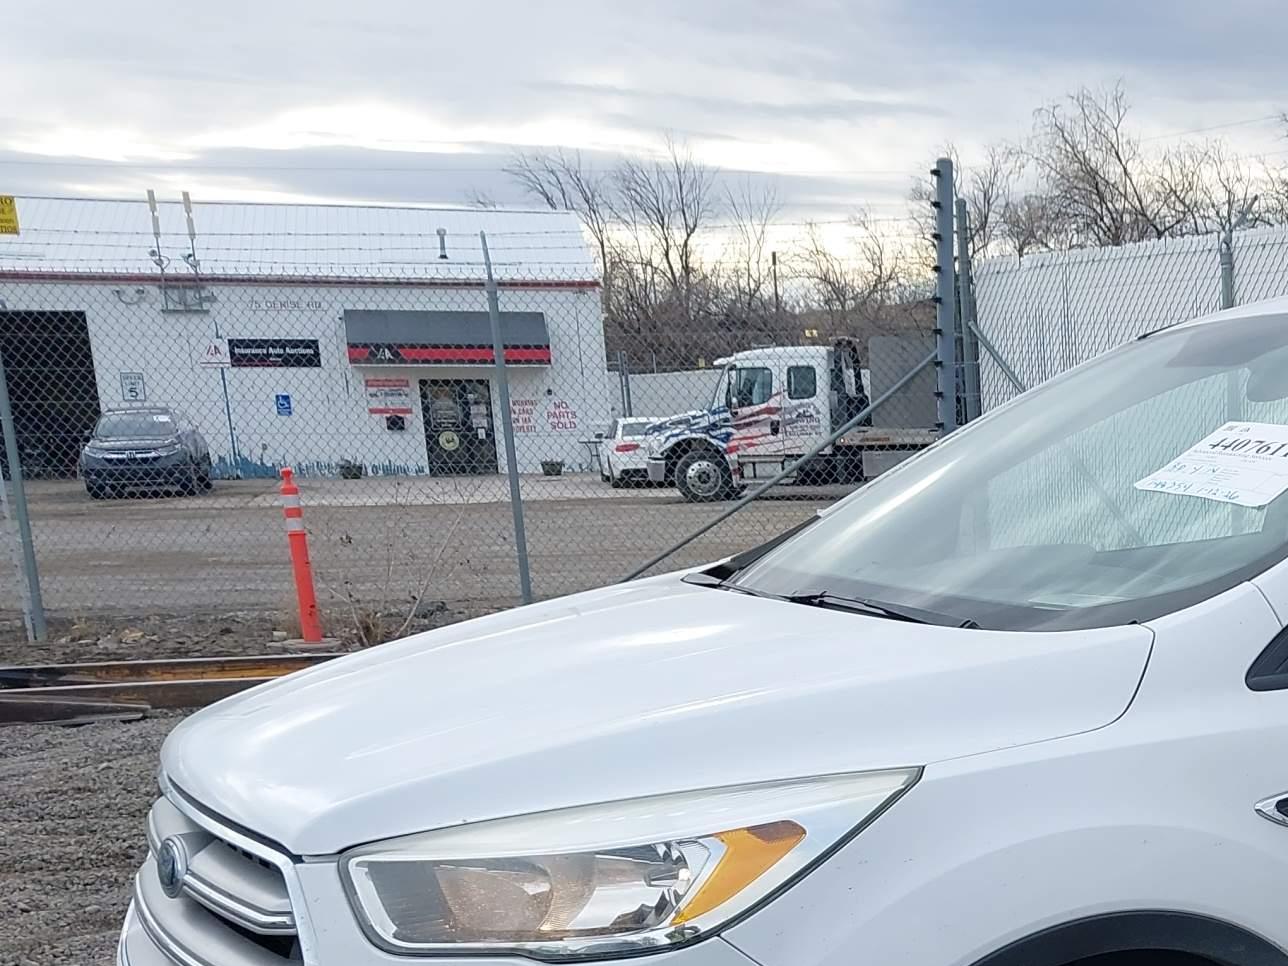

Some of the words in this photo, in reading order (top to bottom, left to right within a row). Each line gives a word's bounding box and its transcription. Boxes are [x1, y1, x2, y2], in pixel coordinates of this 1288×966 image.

[268, 346, 284, 355] Auto
[129, 387, 139, 398] 5
[554, 400, 569, 409] NO
[547, 411, 577, 420] PARTS
[551, 421, 577, 430] SOLD
